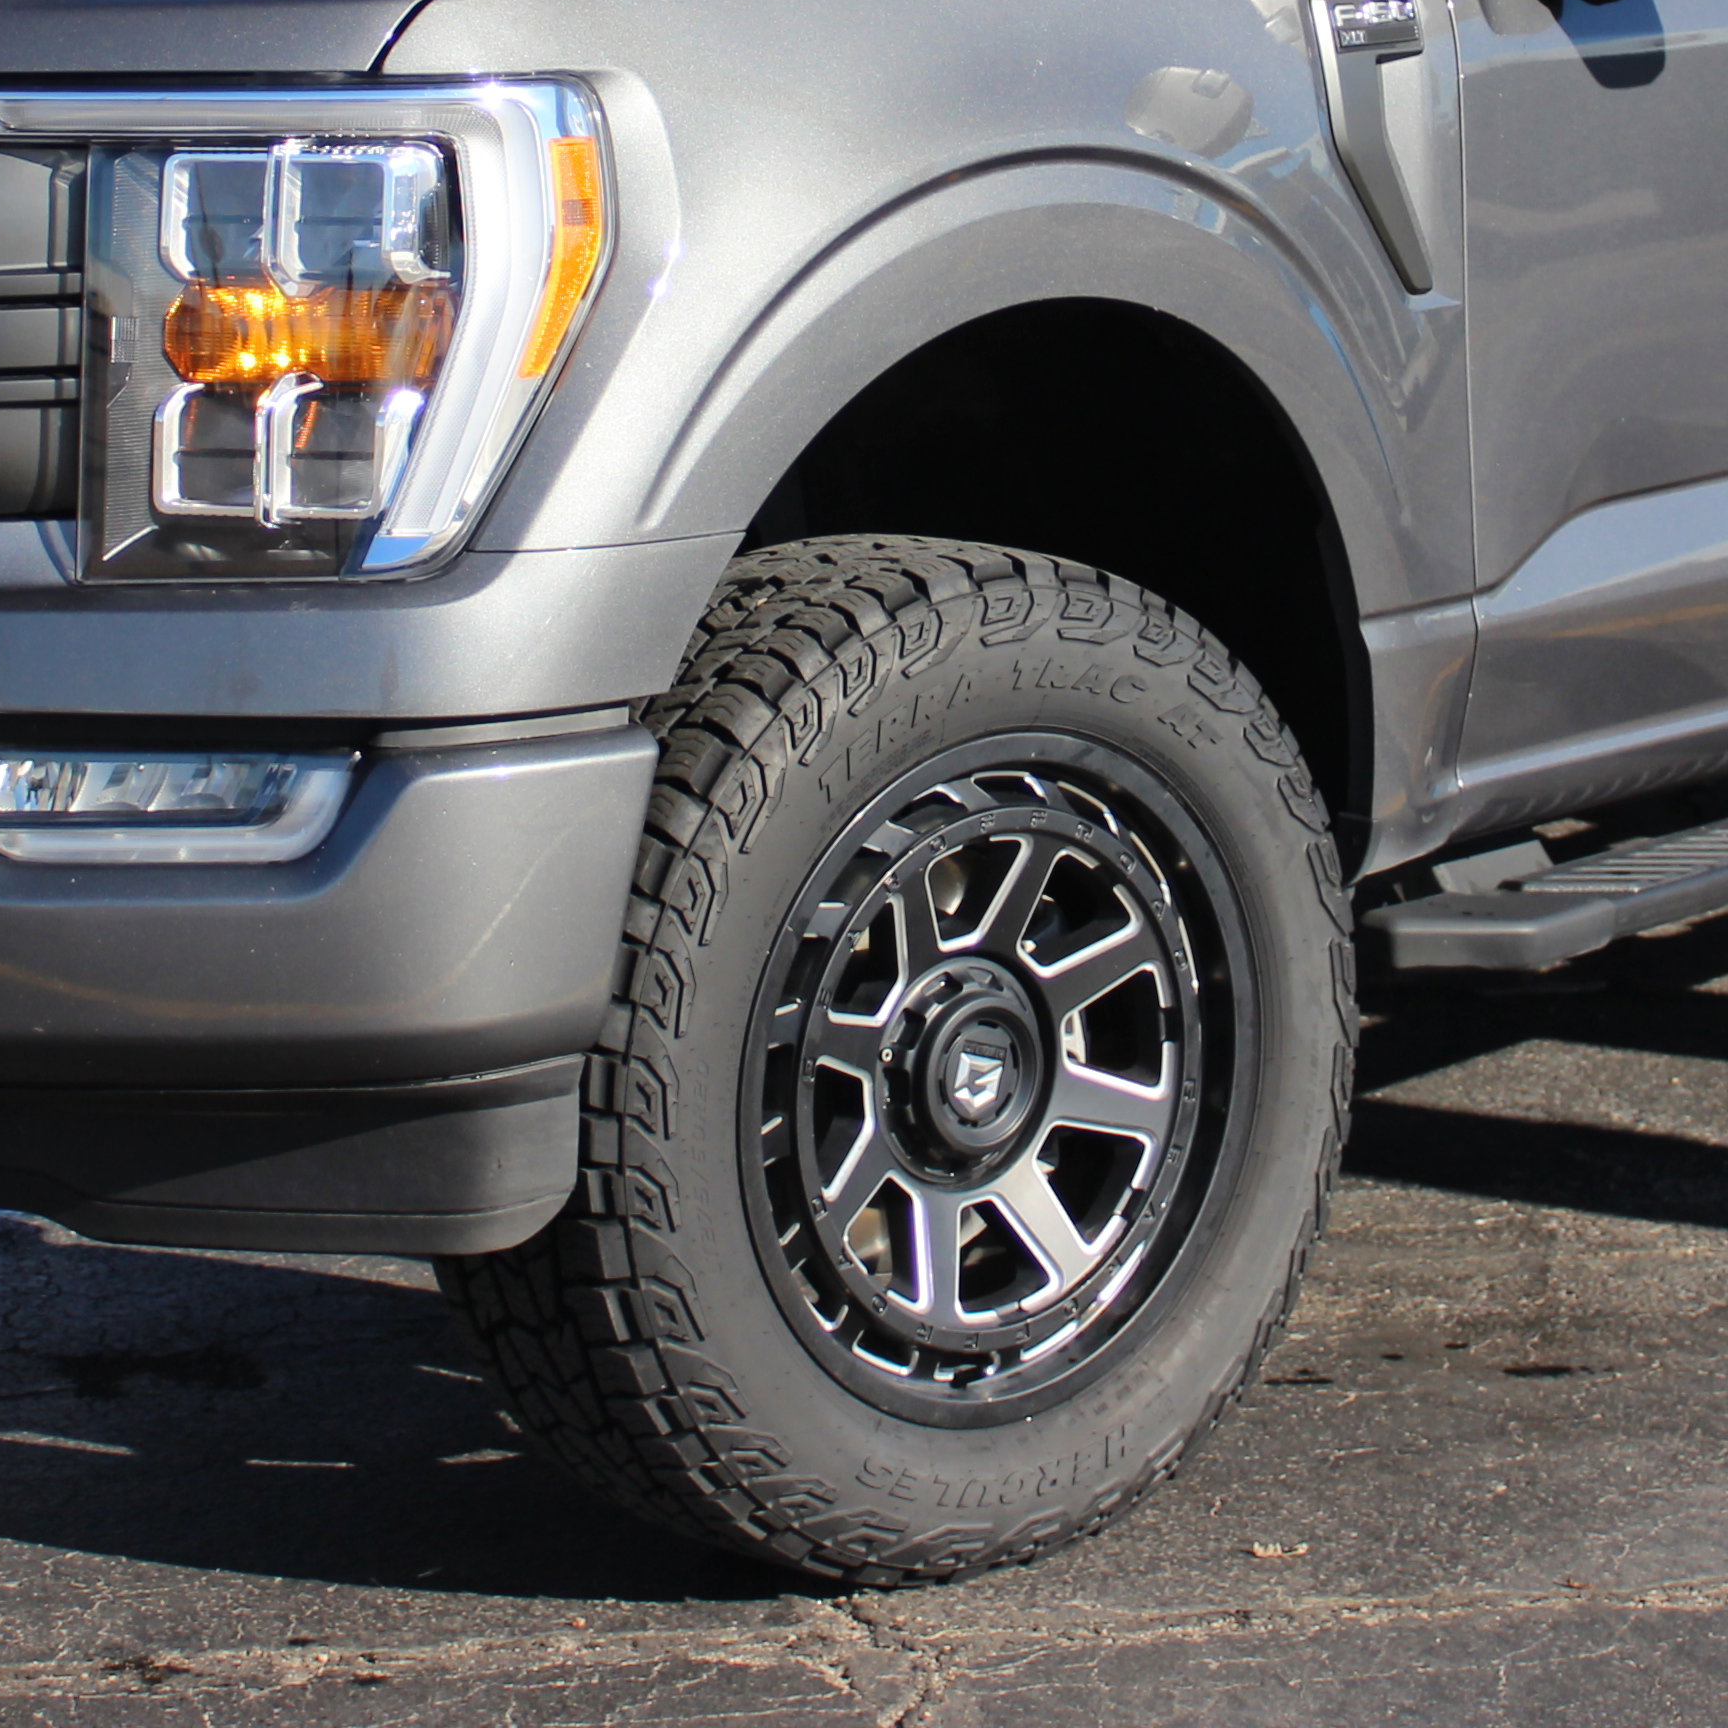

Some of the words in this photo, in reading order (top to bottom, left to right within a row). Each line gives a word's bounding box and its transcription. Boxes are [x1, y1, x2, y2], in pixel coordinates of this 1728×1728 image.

[1339, 29, 1367, 46] XLT
[818, 671, 975, 804] TERRA
[1011, 657, 1150, 704] TRAC
[1157, 703, 1224, 750] AT
[855, 1423, 1132, 1509] HERCULES
